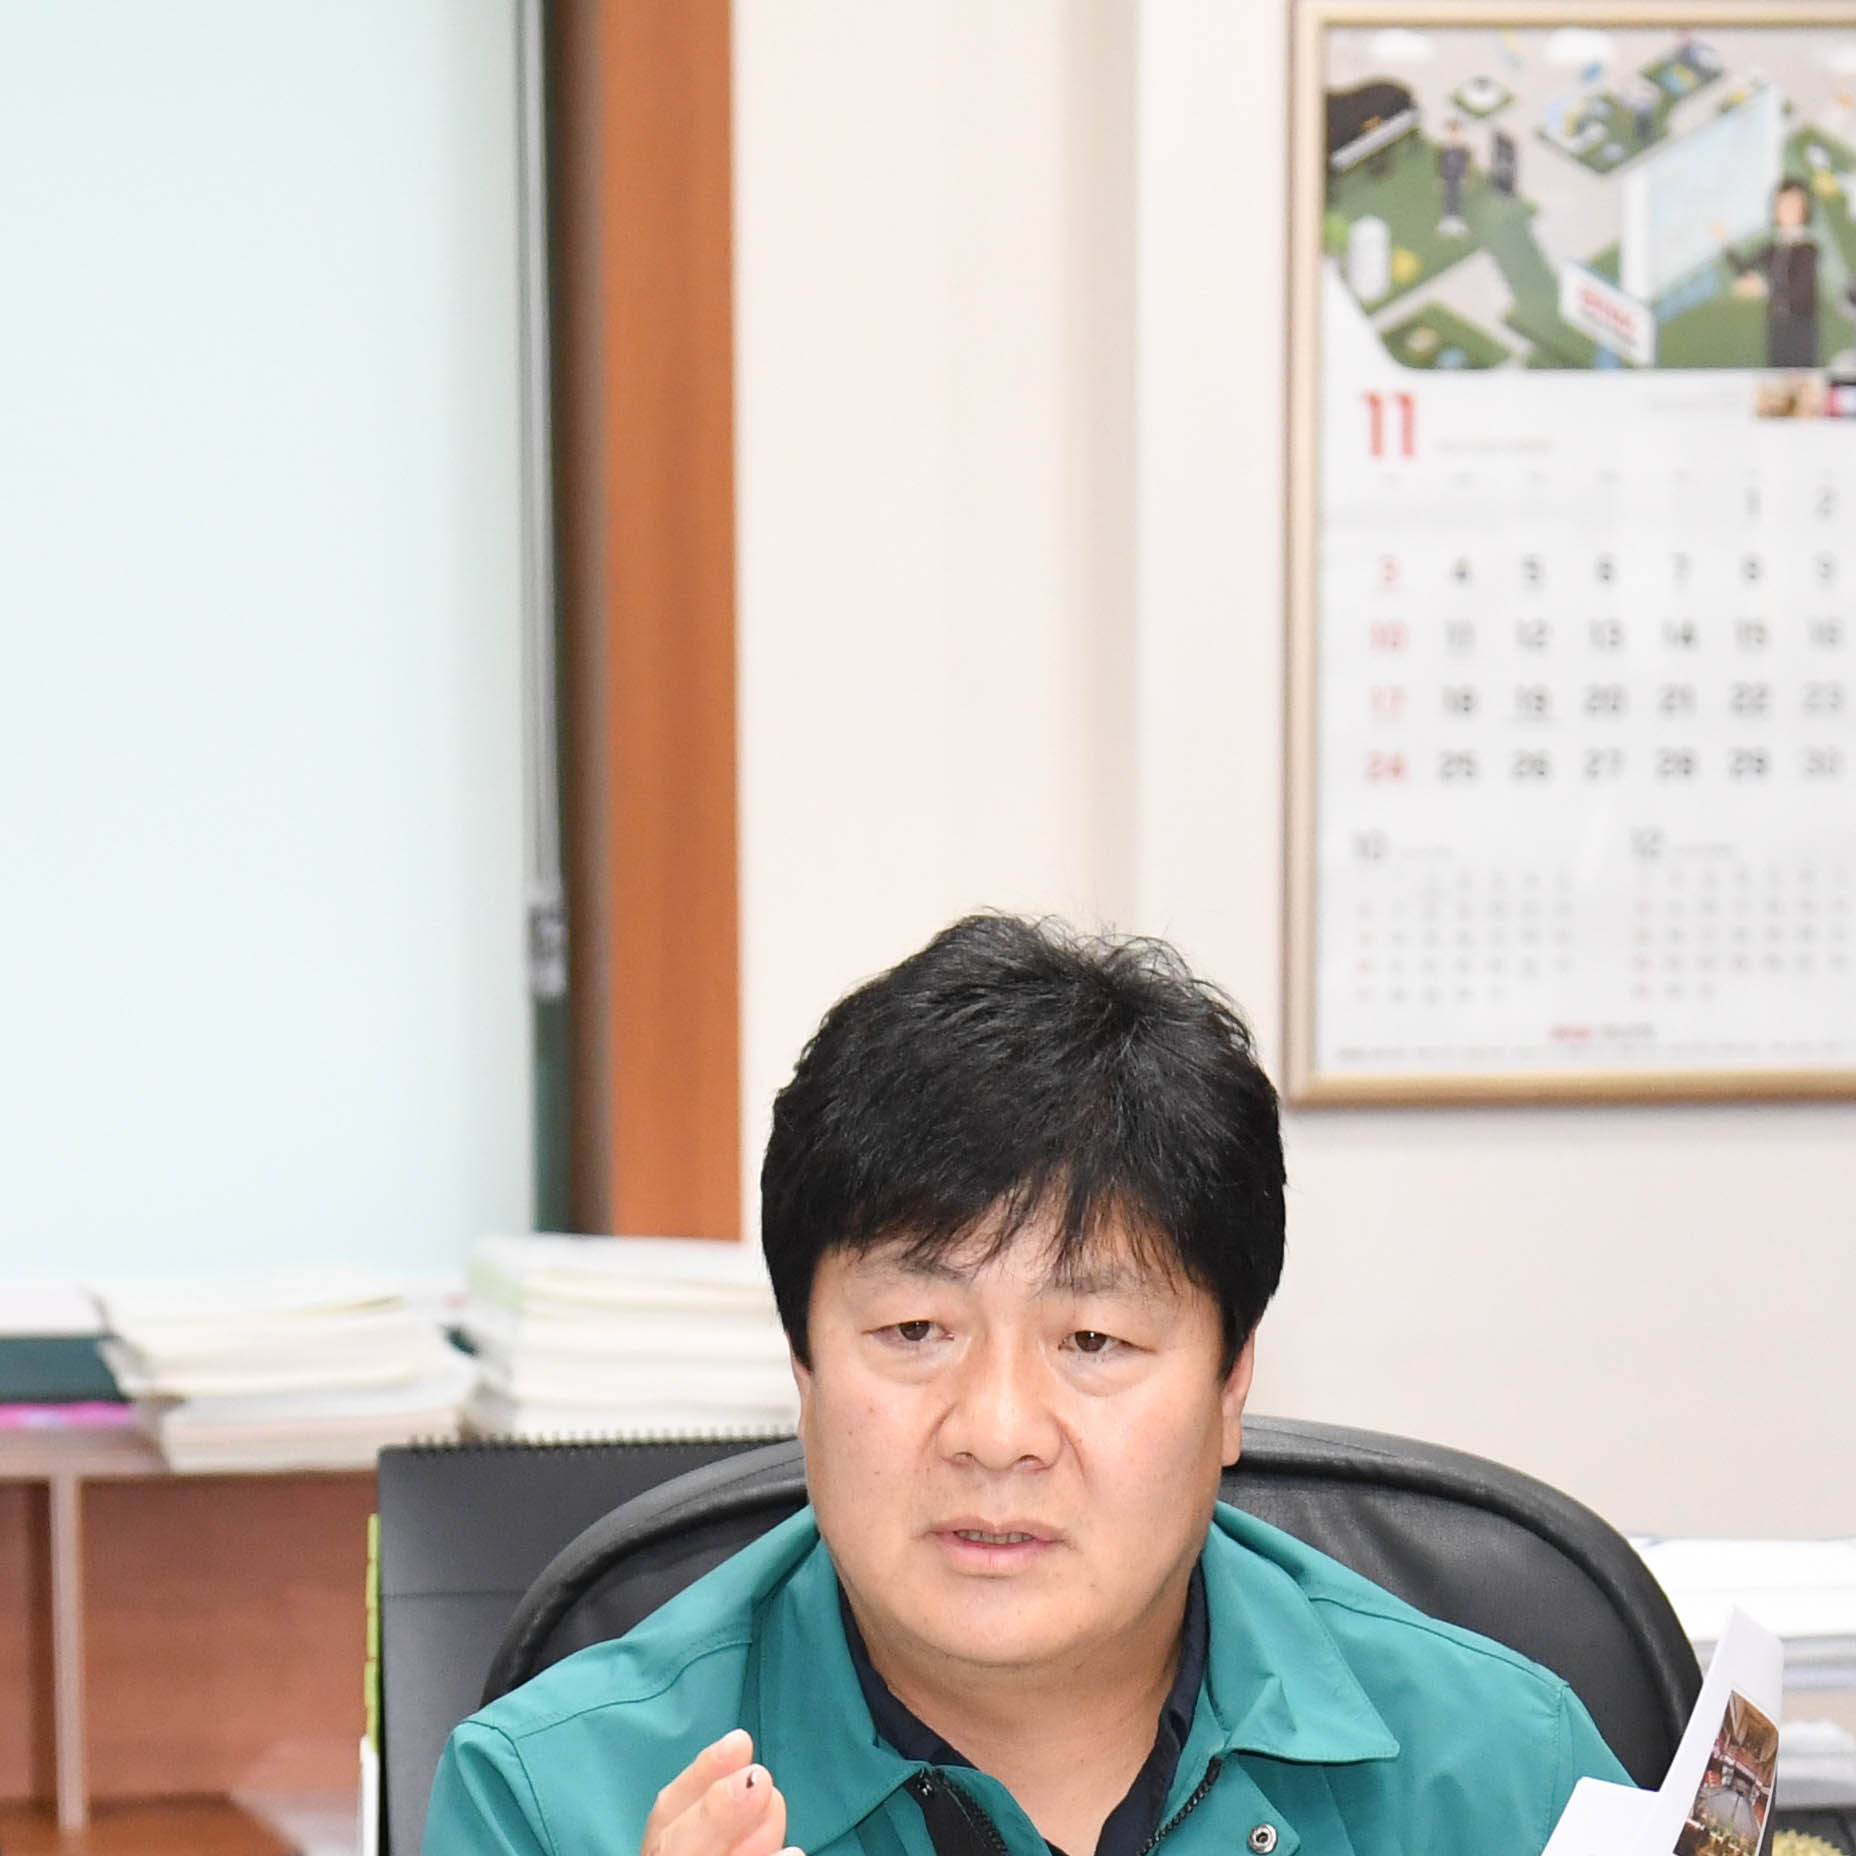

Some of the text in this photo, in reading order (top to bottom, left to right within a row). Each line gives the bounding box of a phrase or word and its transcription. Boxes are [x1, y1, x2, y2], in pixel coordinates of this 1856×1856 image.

[1362, 391, 1417, 458] 11
[1453, 558, 1472, 584] 4
[1674, 554, 1691, 584] 7
[1517, 619, 1549, 650] 12
[1590, 618, 1623, 650] 13
[1663, 618, 1697, 650] 14
[1735, 618, 1769, 649] 15
[1443, 685, 1478, 716] 18
[1515, 684, 1549, 715] 19
[1585, 684, 1626, 714] 20
[1660, 684, 1695, 715] 21
[1730, 682, 1770, 713] 22
[1805, 682, 1843, 712] 23
[1366, 747, 1843, 782] 24 25 26 27 28 29 30
